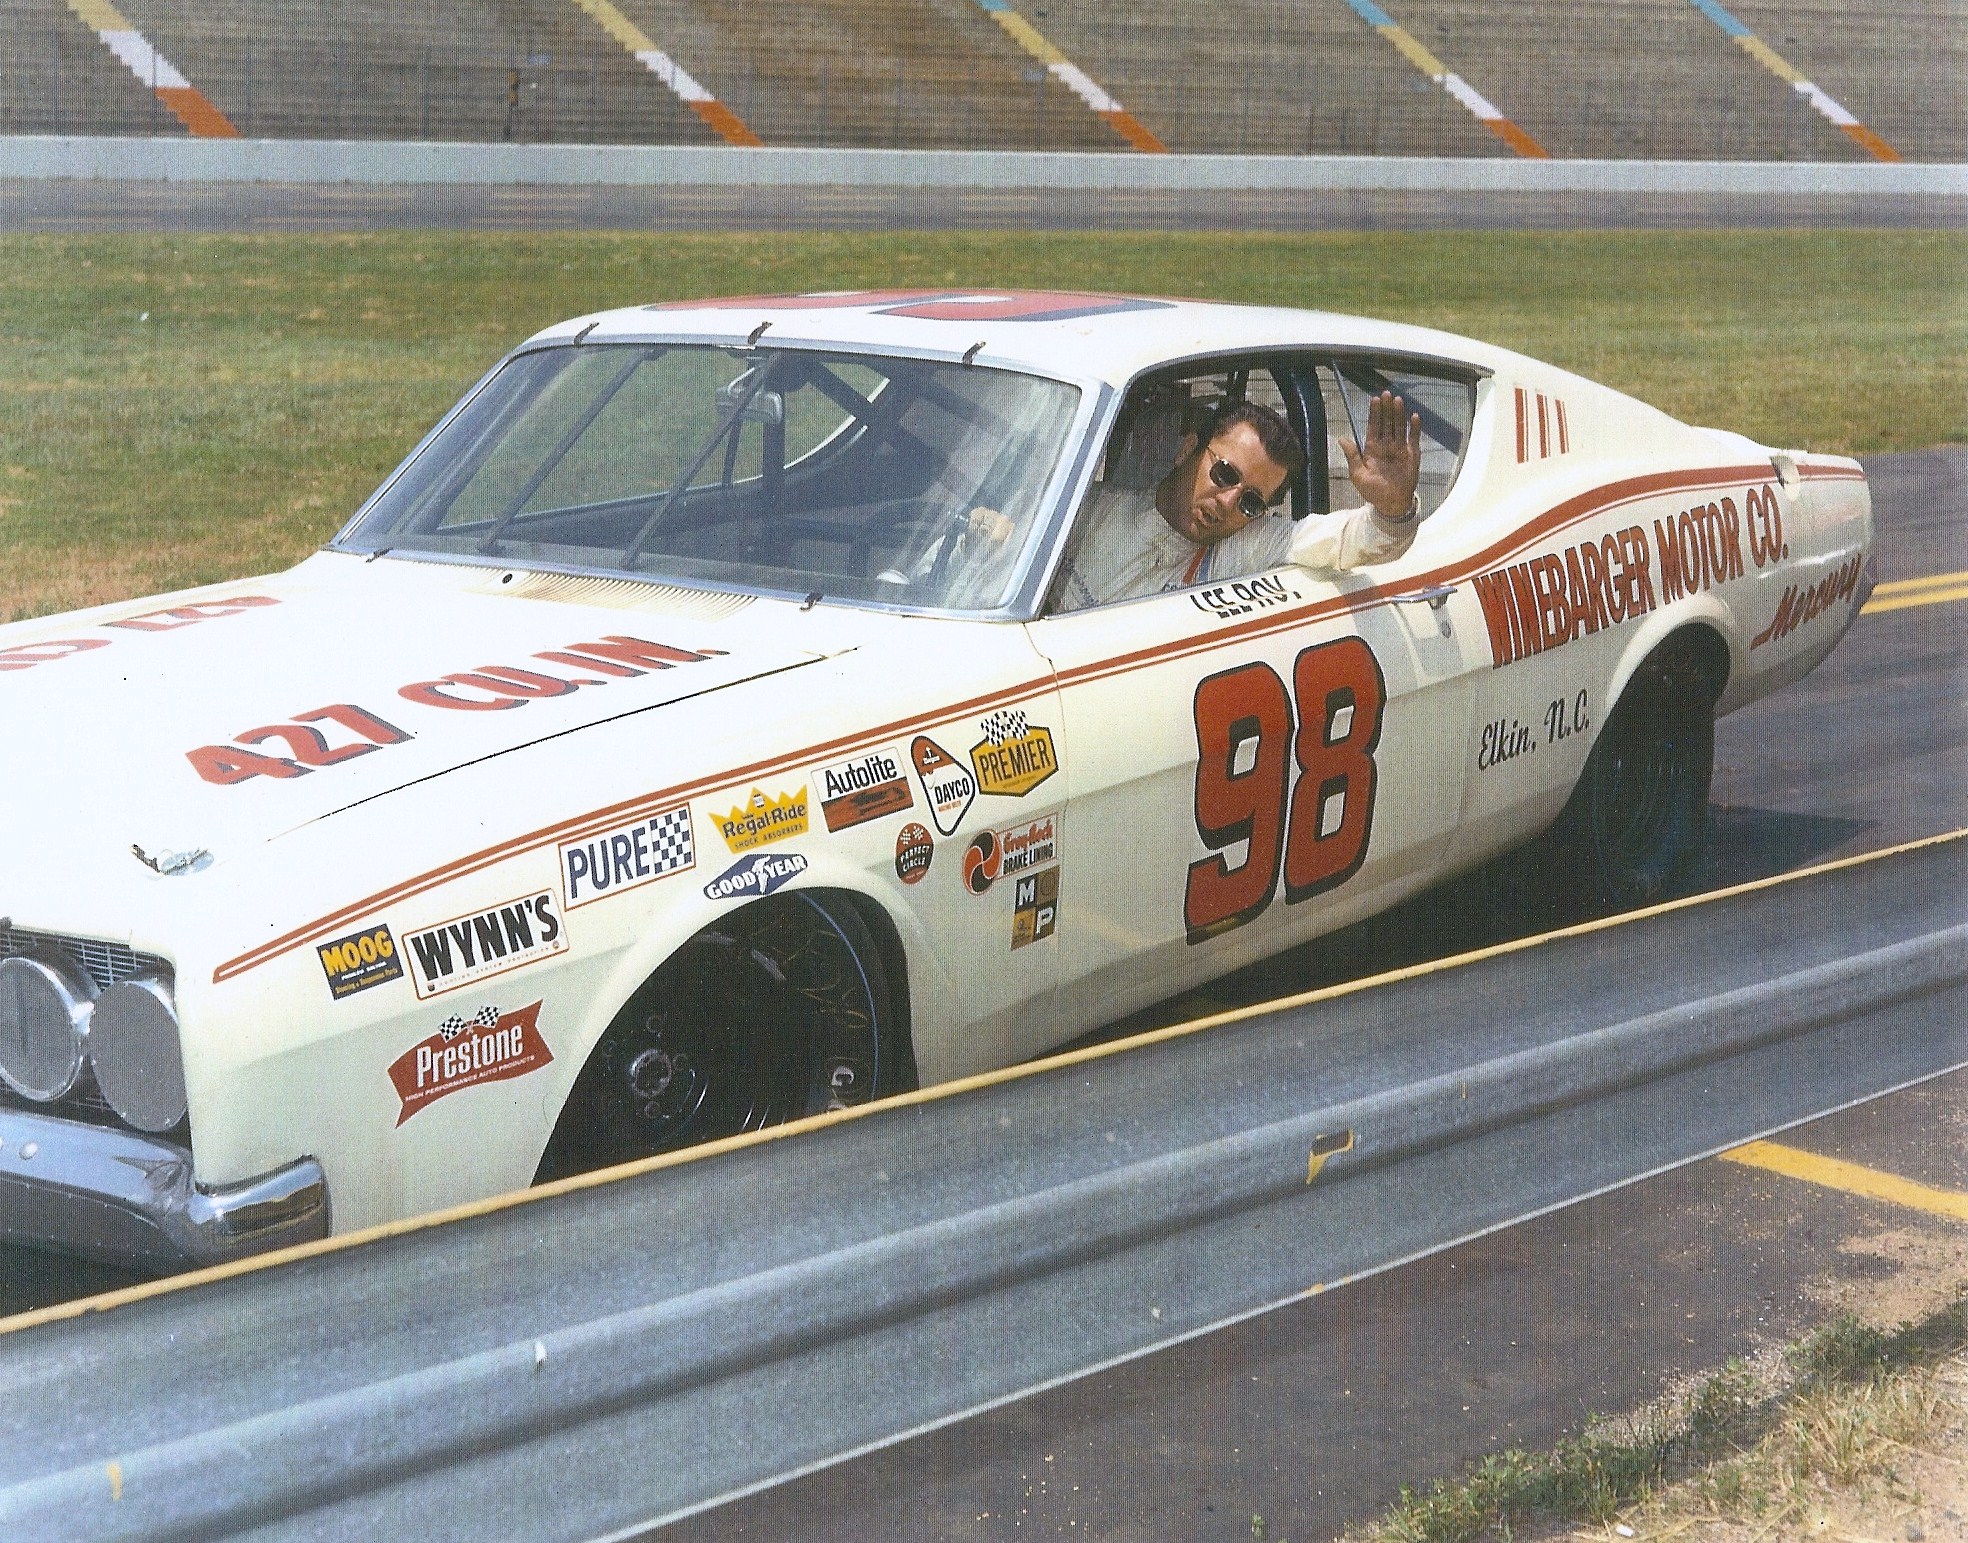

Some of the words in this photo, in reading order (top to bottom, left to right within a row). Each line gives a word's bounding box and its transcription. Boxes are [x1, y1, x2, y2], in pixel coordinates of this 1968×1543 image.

[1190, 591, 1253, 619] LEE
[1231, 575, 1302, 608] ROY
[1472, 525, 1656, 669] WINEBARGER
[1654, 497, 1744, 605] MOTOR
[1746, 484, 1789, 568] CO.
[185, 704, 415, 785] 427
[1479, 719, 1536, 771] Elkin,
[1544, 689, 1589, 743] N.C.
[825, 755, 897, 798] Autolite
[978, 738, 1051, 786] PREMIER
[934, 777, 970, 804] DAYCO
[1184, 635, 1387, 945] 98
[735, 837, 759, 850] SHOCK
[763, 824, 804, 841] ABSORBERS
[900, 845, 930, 863] PERFECT
[1003, 851, 1028, 874] BRAKE
[1029, 843, 1053, 865] LINING
[567, 826, 650, 900] PURE
[902, 857, 926, 873] CIRCLE
[321, 930, 393, 977] MOOG
[411, 895, 559, 981] WYNN'S
[405, 1090, 424, 1101] HIGH
[425, 1075, 478, 1097] PERFORMANCE
[479, 1067, 498, 1078] AUTO
[499, 1055, 535, 1073] PRODUCTS
[416, 1024, 523, 1088] Prestone
